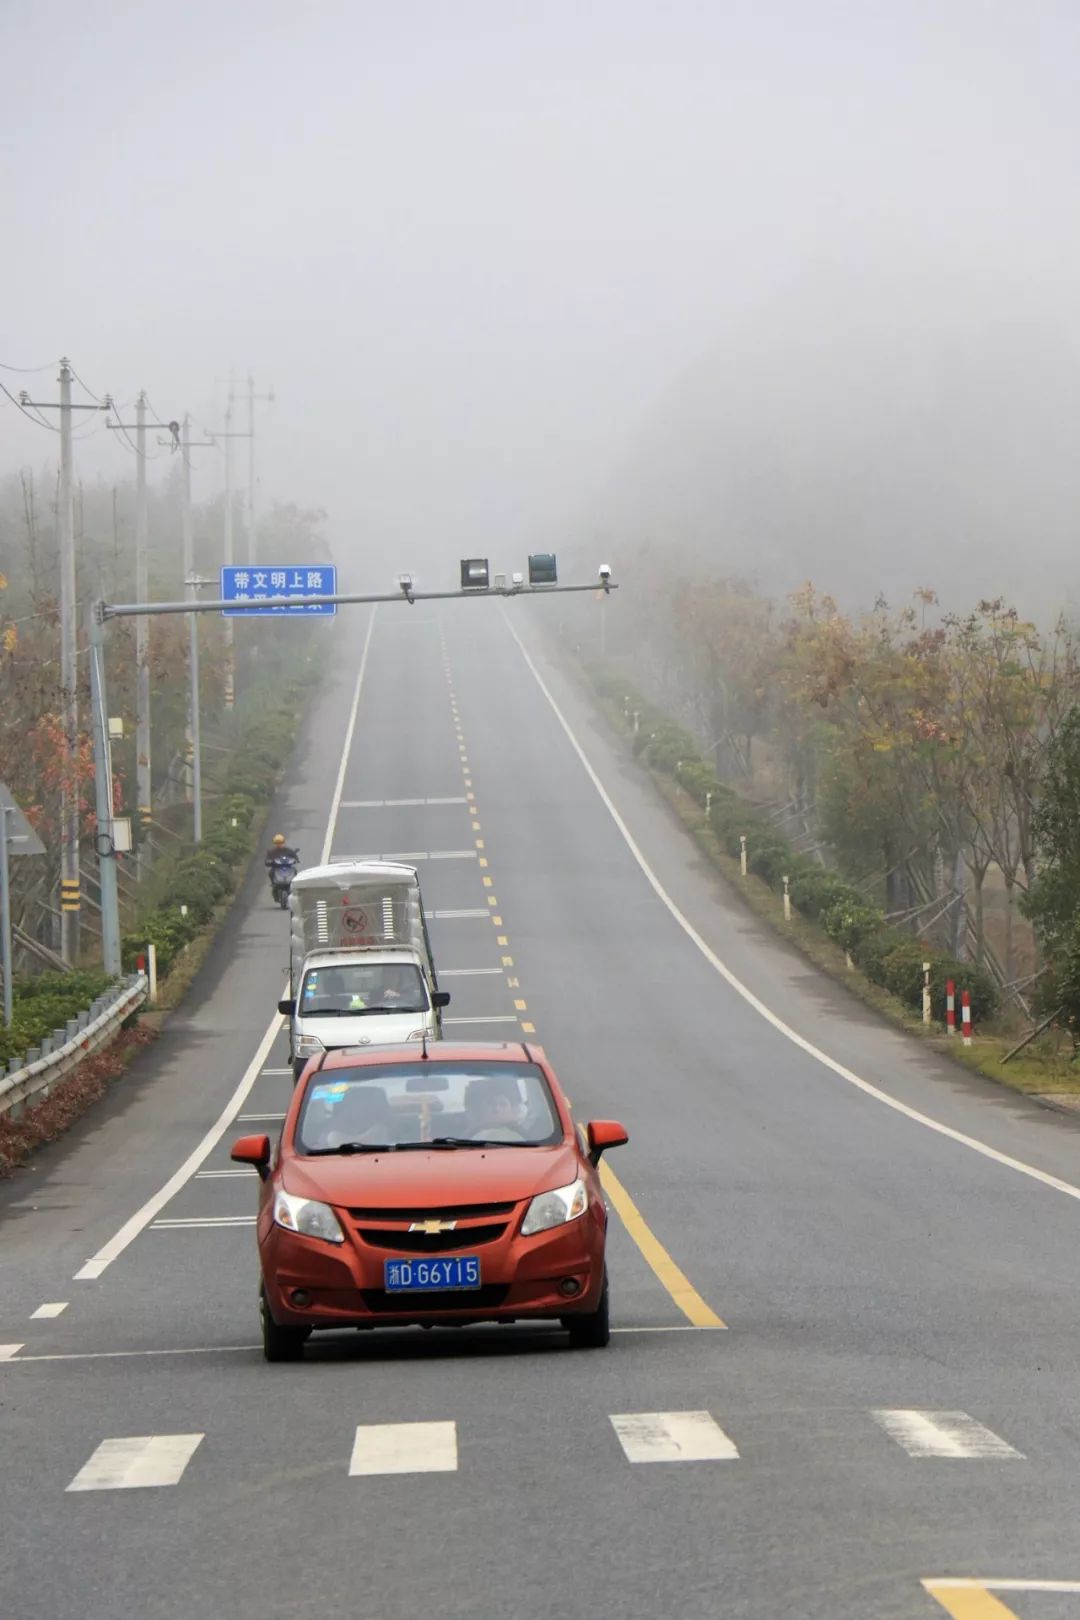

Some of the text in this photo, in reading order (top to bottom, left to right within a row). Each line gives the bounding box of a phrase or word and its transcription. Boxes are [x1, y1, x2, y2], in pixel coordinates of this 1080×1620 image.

[233, 571, 323, 589] 带文明上路
